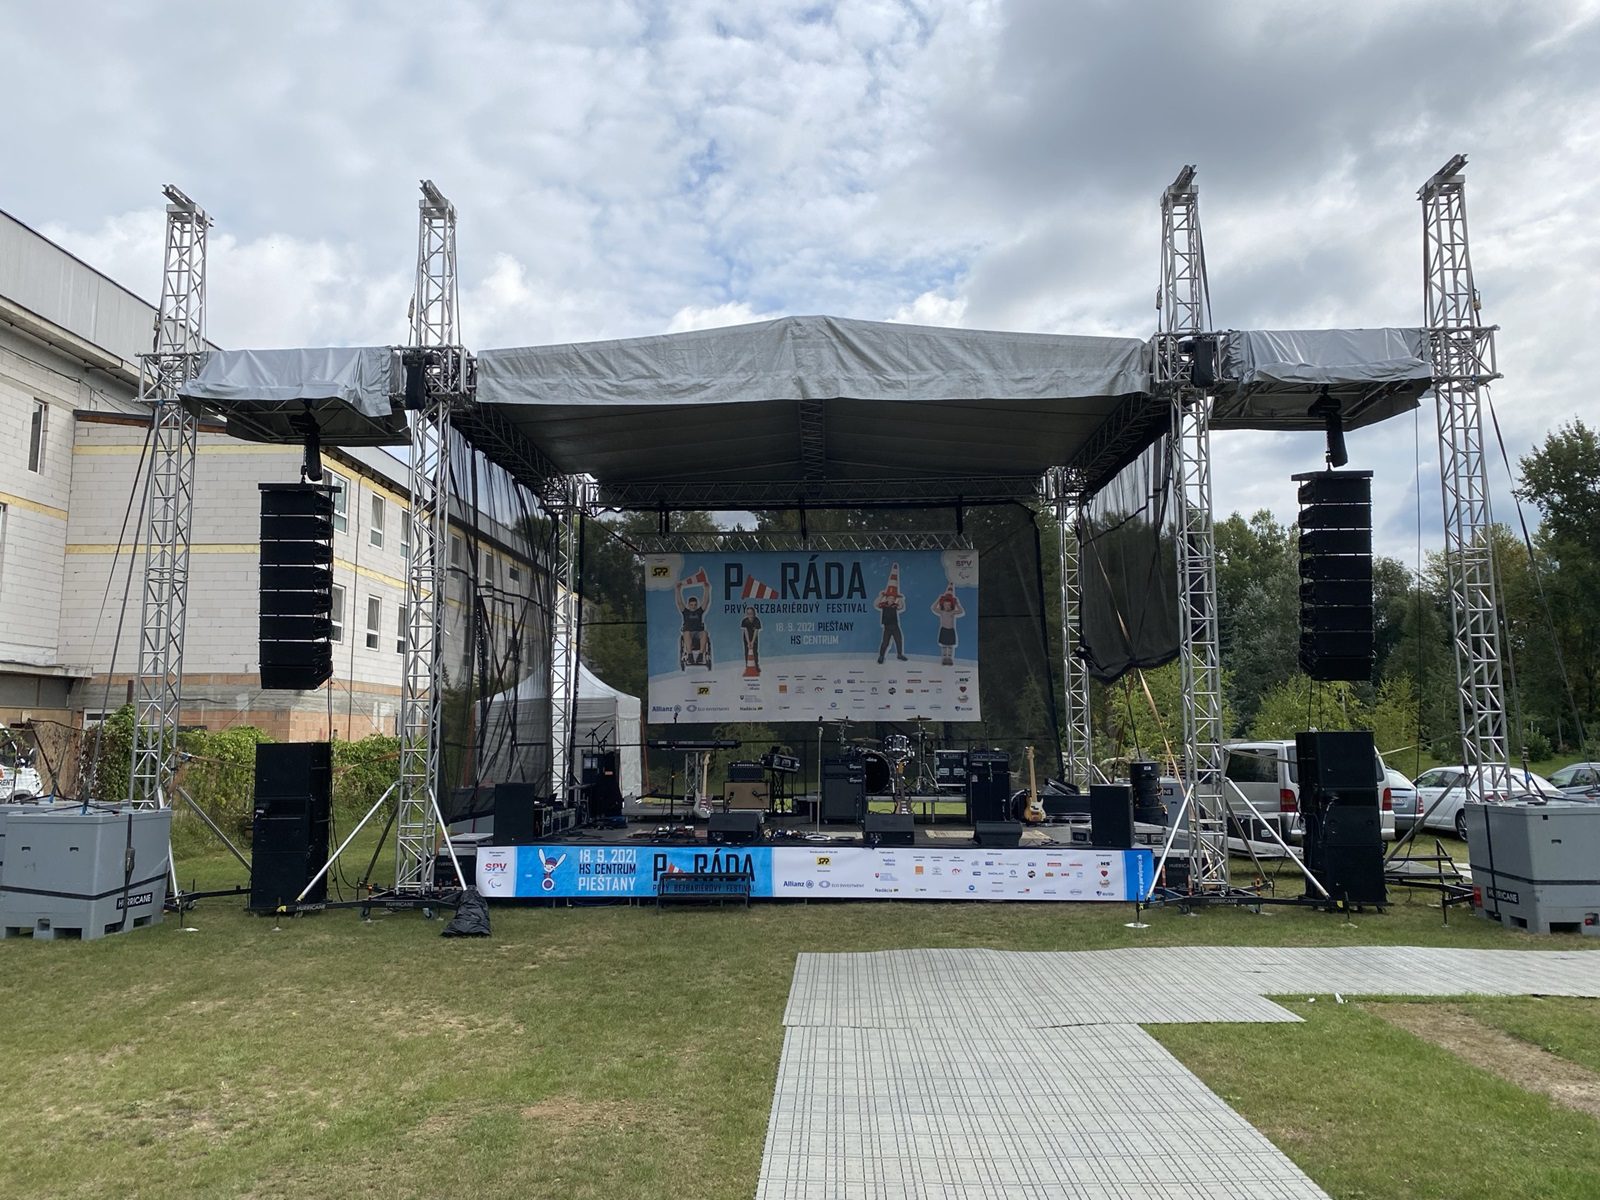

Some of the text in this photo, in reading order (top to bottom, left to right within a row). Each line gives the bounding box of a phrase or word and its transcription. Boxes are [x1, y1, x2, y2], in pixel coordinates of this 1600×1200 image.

[652, 567, 669, 577] SPP
[724, 602, 747, 614] PRVÝ
[826, 603, 867, 613] FESTIVAL
[797, 622, 815, 632] 2021
[790, 635, 840, 645] HS CENTRUM
[579, 848, 636, 863] 18. 9. 2021
[484, 862, 508, 872] SPV
[579, 863, 637, 875] HS CENTRUM
[783, 880, 805, 888] Allianz
[117, 893, 152, 908] HRRICANE
